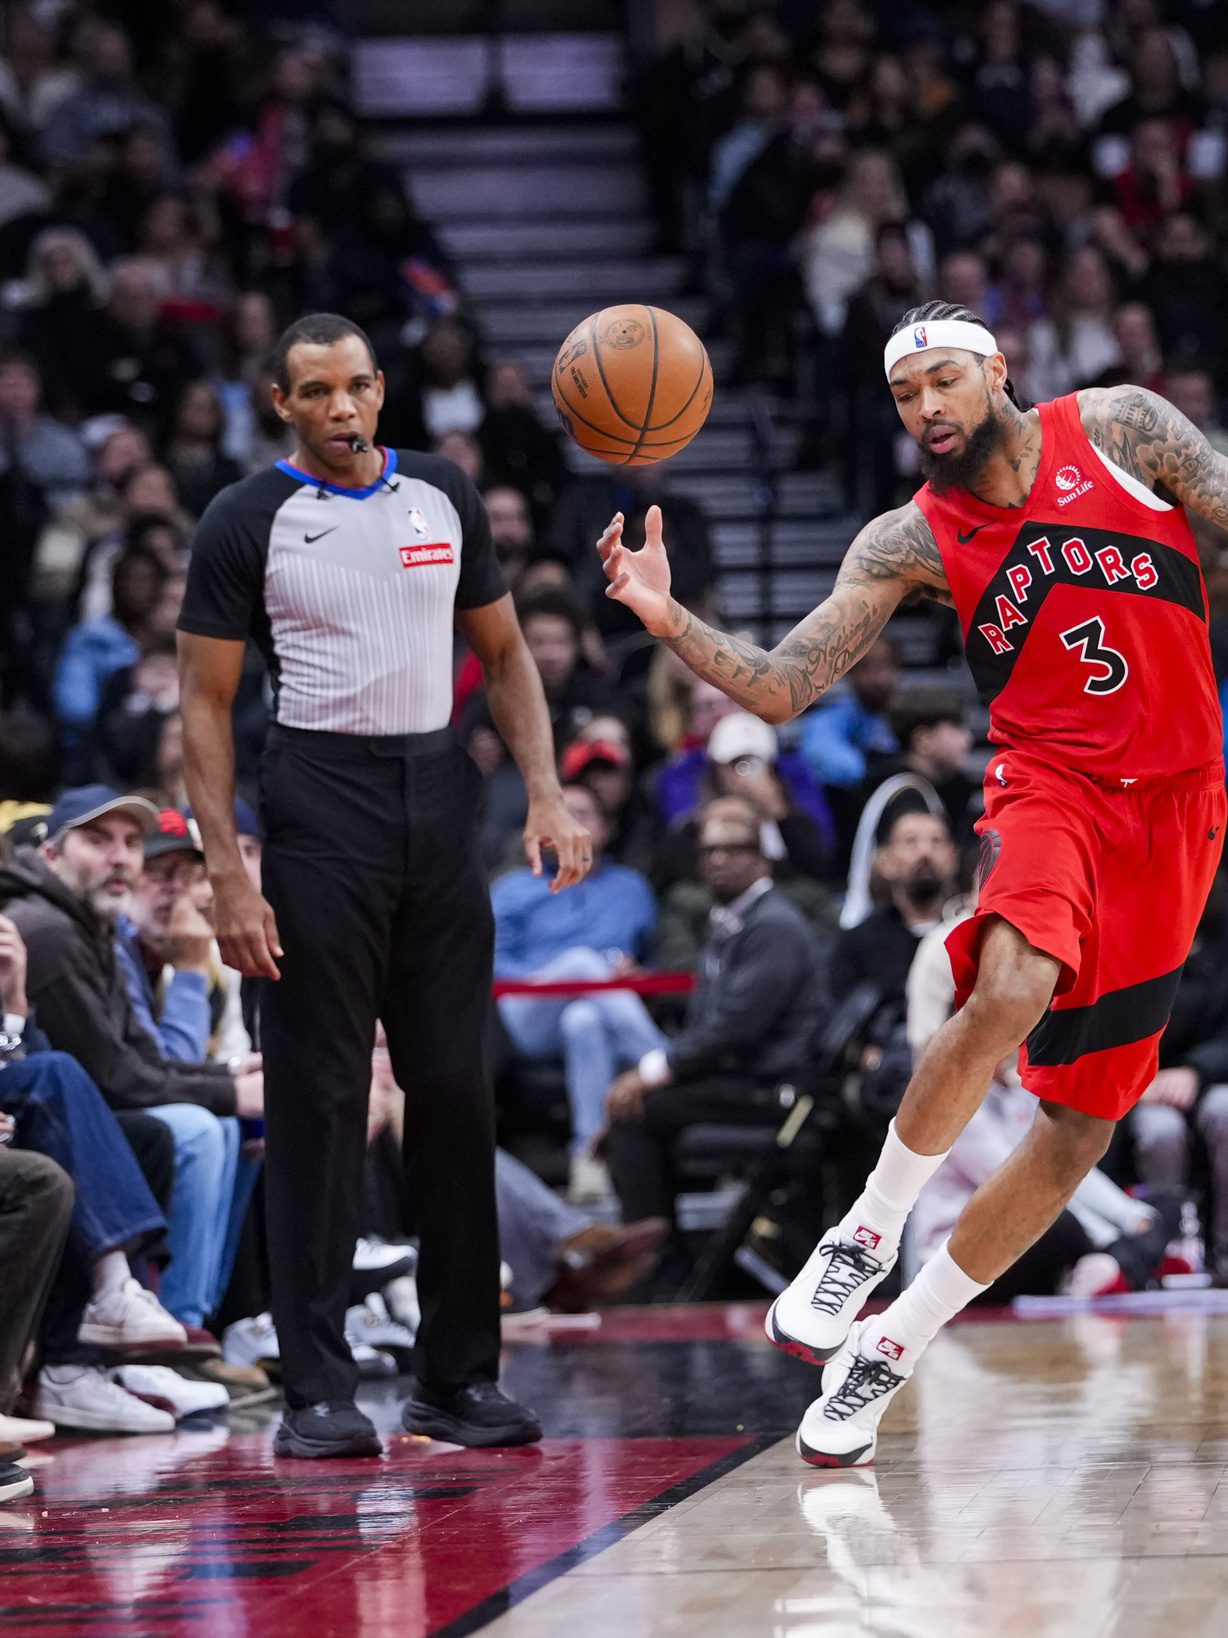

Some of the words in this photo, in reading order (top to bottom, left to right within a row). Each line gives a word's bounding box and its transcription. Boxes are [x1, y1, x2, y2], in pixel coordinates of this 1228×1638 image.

[1057, 492, 1077, 507] Sun
[1075, 480, 1094, 495] Life
[400, 547, 454, 564] Emirates
[978, 536, 1159, 655] RAPTORS
[1059, 616, 1129, 696] 3
